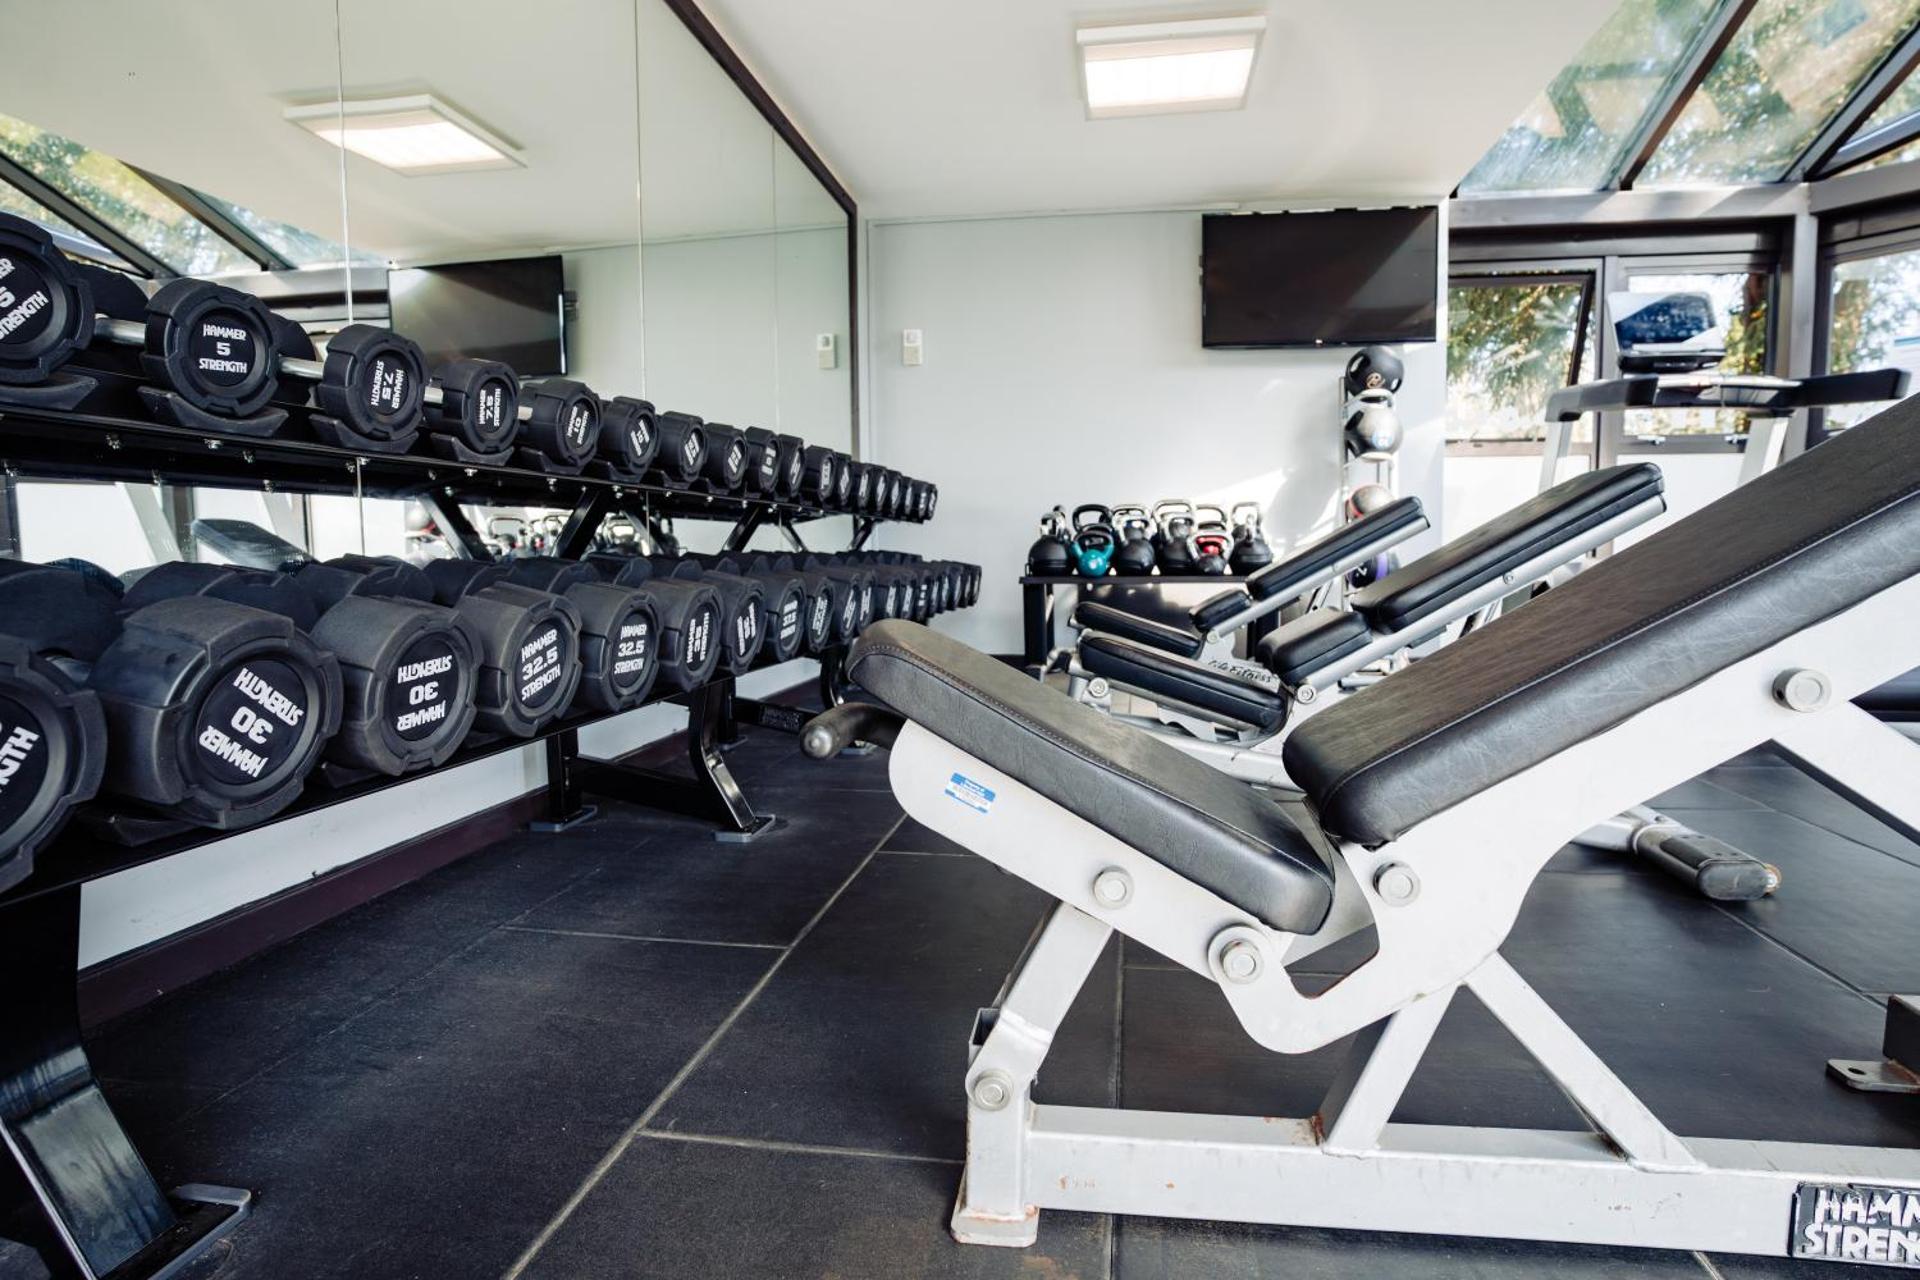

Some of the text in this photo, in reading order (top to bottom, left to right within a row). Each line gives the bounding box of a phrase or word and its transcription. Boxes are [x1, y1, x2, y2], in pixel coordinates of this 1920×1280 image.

[203, 324, 246, 341] HAMMER
[216, 342, 231, 356] 5
[199, 358, 247, 374] STRENGTH
[370, 360, 385, 406] STRENGTH
[382, 372, 394, 400] 7.5
[391, 369, 404, 409] HAMMER
[486, 395, 494, 419] 7.5
[522, 628, 558, 663] HAMMER
[621, 623, 647, 640] HAMMER
[522, 646, 558, 680] 32.5
[618, 640, 644, 657] 32.5
[397, 654, 452, 684] STRENGTH
[614, 658, 644, 675] STRENGTH
[233, 667, 304, 727] STRENGTH
[409, 684, 439, 705] 30
[521, 664, 561, 701] STRENGTH
[231, 705, 273, 745] 30
[397, 700, 446, 731] HAMMER
[199, 725, 269, 778] HAMMER
